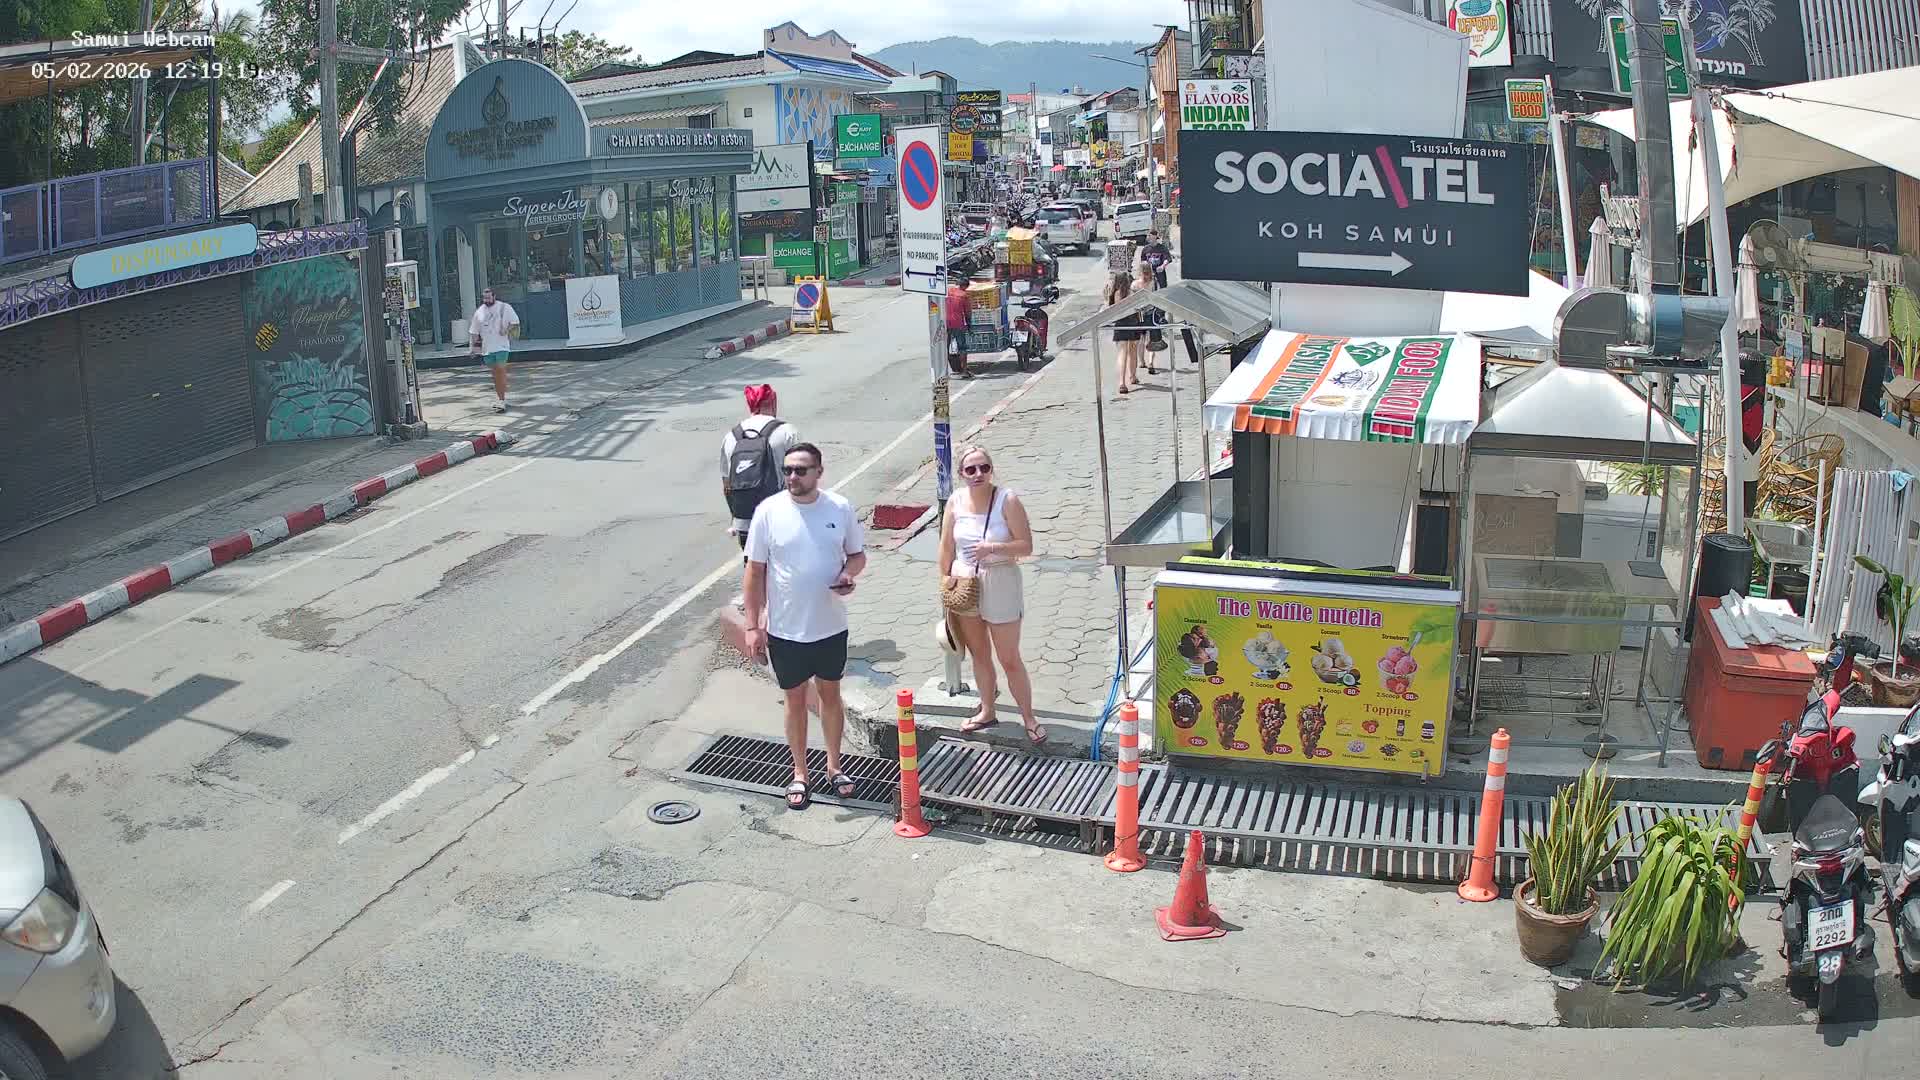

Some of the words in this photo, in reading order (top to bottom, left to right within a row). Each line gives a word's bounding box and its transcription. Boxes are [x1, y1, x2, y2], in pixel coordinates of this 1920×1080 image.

[1185, 93, 1249, 106] FLAVORS
[1510, 91, 1543, 104] INDIAN
[1183, 106, 1250, 123] INDIAN
[1513, 104, 1543, 118] FOOD
[611, 134, 655, 148] CHAWENG
[658, 133, 692, 146] GARDEN
[693, 133, 718, 146] BEACH
[720, 132, 748, 146] RESORT
[839, 141, 881, 152] EXCHANGE
[1409, 140, 1507, 159] โรงแรมโซเชียลเทล
[668, 178, 716, 207] SuperJay
[502, 189, 590, 228] SuperJay
[1257, 220, 1324, 240] KOH
[1345, 223, 1453, 247] SAMUI
[111, 235, 224, 275] DISPENSARY
[773, 248, 813, 257] EXCHANGE
[906, 250, 915, 260] NO
[915, 251, 940, 261] PARKING
[299, 334, 346, 347] THAILAND
[1370, 377, 1430, 438] INDIAN
[1402, 339, 1444, 378] FOOD
[1217, 598, 1250, 617] The
[1256, 600, 1313, 622] Waffle
[1317, 607, 1383, 629] nutella
[1363, 703, 1413, 717] Topping
[1815, 930, 1847, 948] 2292
[1818, 955, 1841, 972] 28
